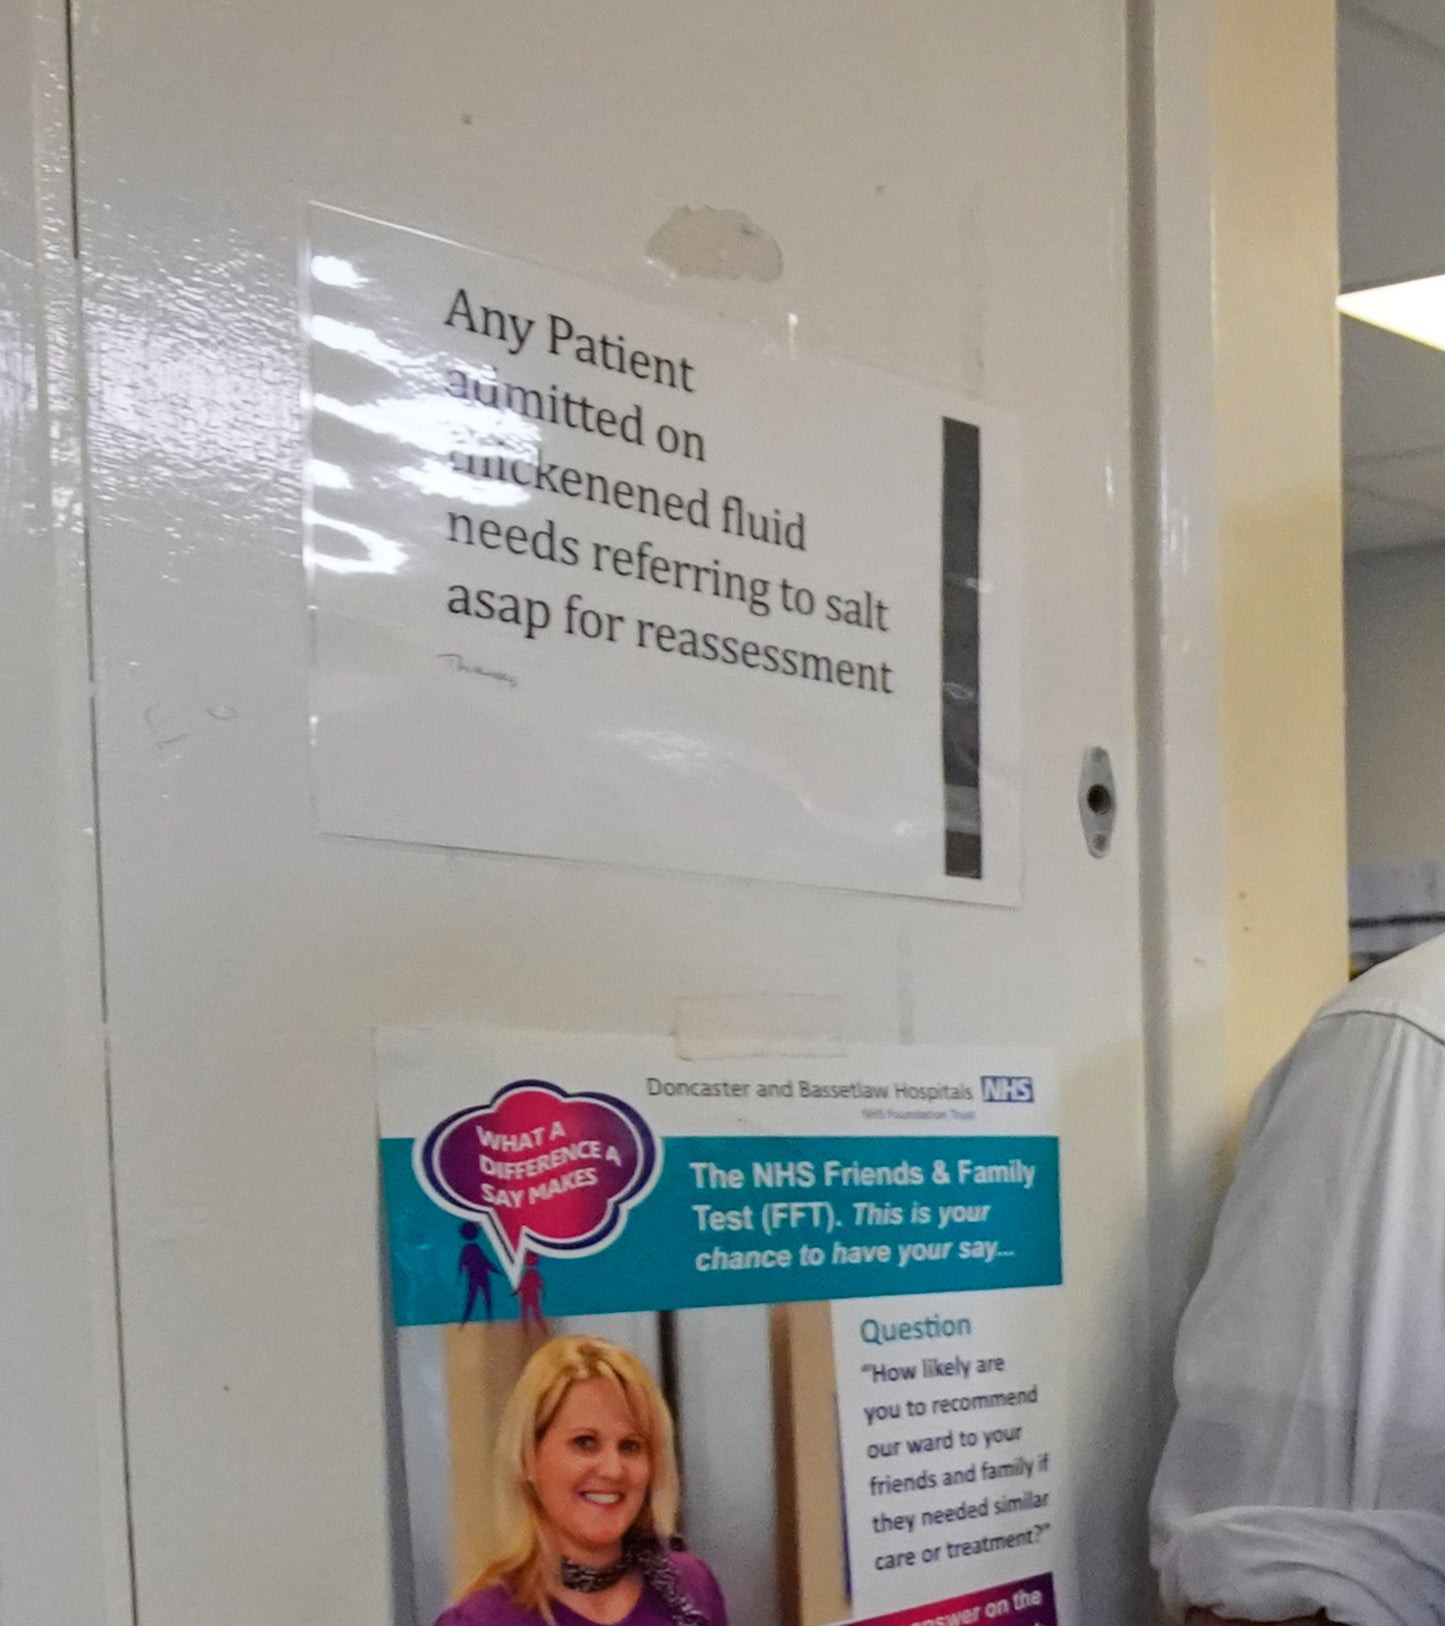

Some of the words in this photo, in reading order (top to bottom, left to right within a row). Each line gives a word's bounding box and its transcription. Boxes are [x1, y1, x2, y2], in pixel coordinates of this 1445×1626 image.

[444, 288, 535, 355] Any
[547, 313, 695, 393] Patient
[444, 366, 645, 447] admitted
[657, 423, 706, 462] on
[722, 494, 807, 552] fluid
[447, 511, 579, 567] needs
[593, 542, 771, 617] referring
[780, 578, 815, 616] to
[827, 591, 889, 632] salt
[447, 583, 551, 640] asap
[564, 594, 624, 643] for
[636, 618, 895, 694] reassessment
[647, 1077, 750, 1097] Doncaster
[757, 1080, 794, 1098] and
[799, 1080, 888, 1099] Bassetlaw
[896, 1080, 974, 1101] Hospitals
[982, 1077, 1033, 1102] NHS
[476, 1125, 545, 1153] WHAT
[549, 1121, 566, 1141] A
[479, 1140, 602, 1180] DIFFERENCE
[605, 1146, 622, 1167] A
[689, 1162, 744, 1189] The
[752, 1161, 816, 1187] NHS
[824, 1160, 924, 1186] Friends
[932, 1159, 951, 1184] &
[957, 1158, 1036, 1189] Family
[481, 1183, 524, 1208] SAY
[529, 1167, 599, 1204] MAKES
[692, 1205, 753, 1231] Test
[762, 1202, 842, 1236] (FFT).
[853, 1202, 903, 1225] This
[911, 1202, 931, 1224] is
[938, 1204, 991, 1228] your
[695, 1247, 792, 1271] chance
[799, 1244, 825, 1266] to
[832, 1242, 892, 1265] have
[898, 1242, 953, 1267] your
[860, 1314, 972, 1345] Question
[922, 1356, 970, 1380] likely
[976, 1356, 1005, 1374] are
[864, 1403, 900, 1426] you
[907, 1399, 926, 1416] to
[932, 1384, 1038, 1414] recommend
[867, 1440, 900, 1459] our
[906, 1430, 953, 1453] ward
[960, 1430, 977, 1447] to
[983, 1426, 1022, 1449] your
[870, 1470, 937, 1496] friends
[943, 1463, 976, 1485] and
[982, 1455, 1034, 1482] family
[1038, 1452, 1049, 1472] if
[872, 1513, 915, 1534] they
[921, 1498, 988, 1526] needed
[994, 1491, 1049, 1515] similar
[875, 1549, 916, 1571] care
[921, 1545, 941, 1564] or
[984, 1598, 1009, 1618] on
[1012, 1588, 1042, 1611] the
